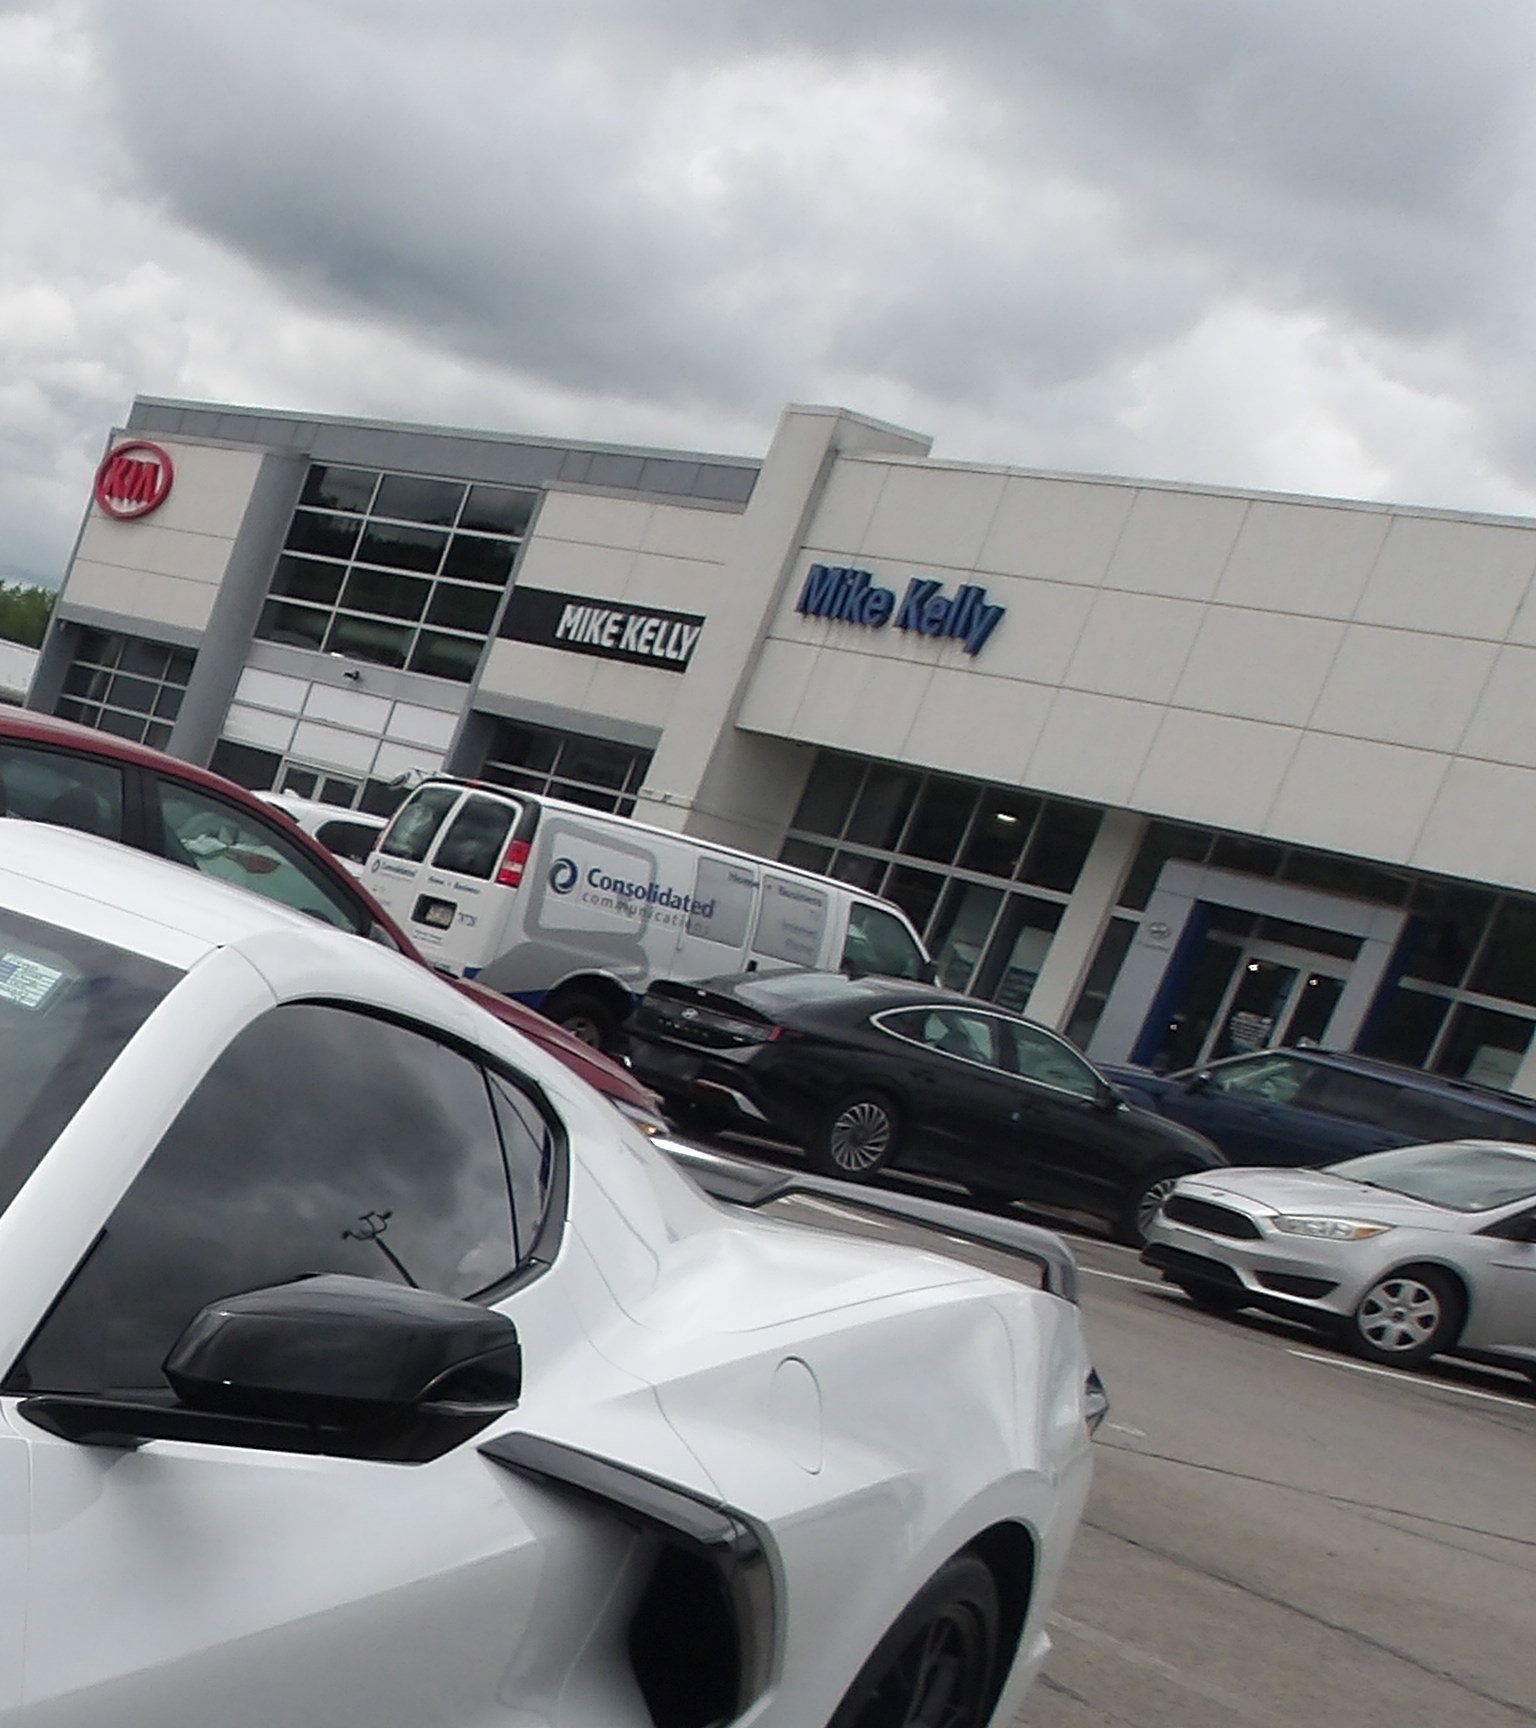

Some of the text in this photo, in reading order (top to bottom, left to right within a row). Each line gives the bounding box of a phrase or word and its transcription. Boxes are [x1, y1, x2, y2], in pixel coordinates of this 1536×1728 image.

[103, 456, 161, 504] KIA
[555, 603, 701, 661] MIKE KELLY
[794, 563, 1007, 659] Mike Kelly
[587, 868, 716, 919] Consolidated
